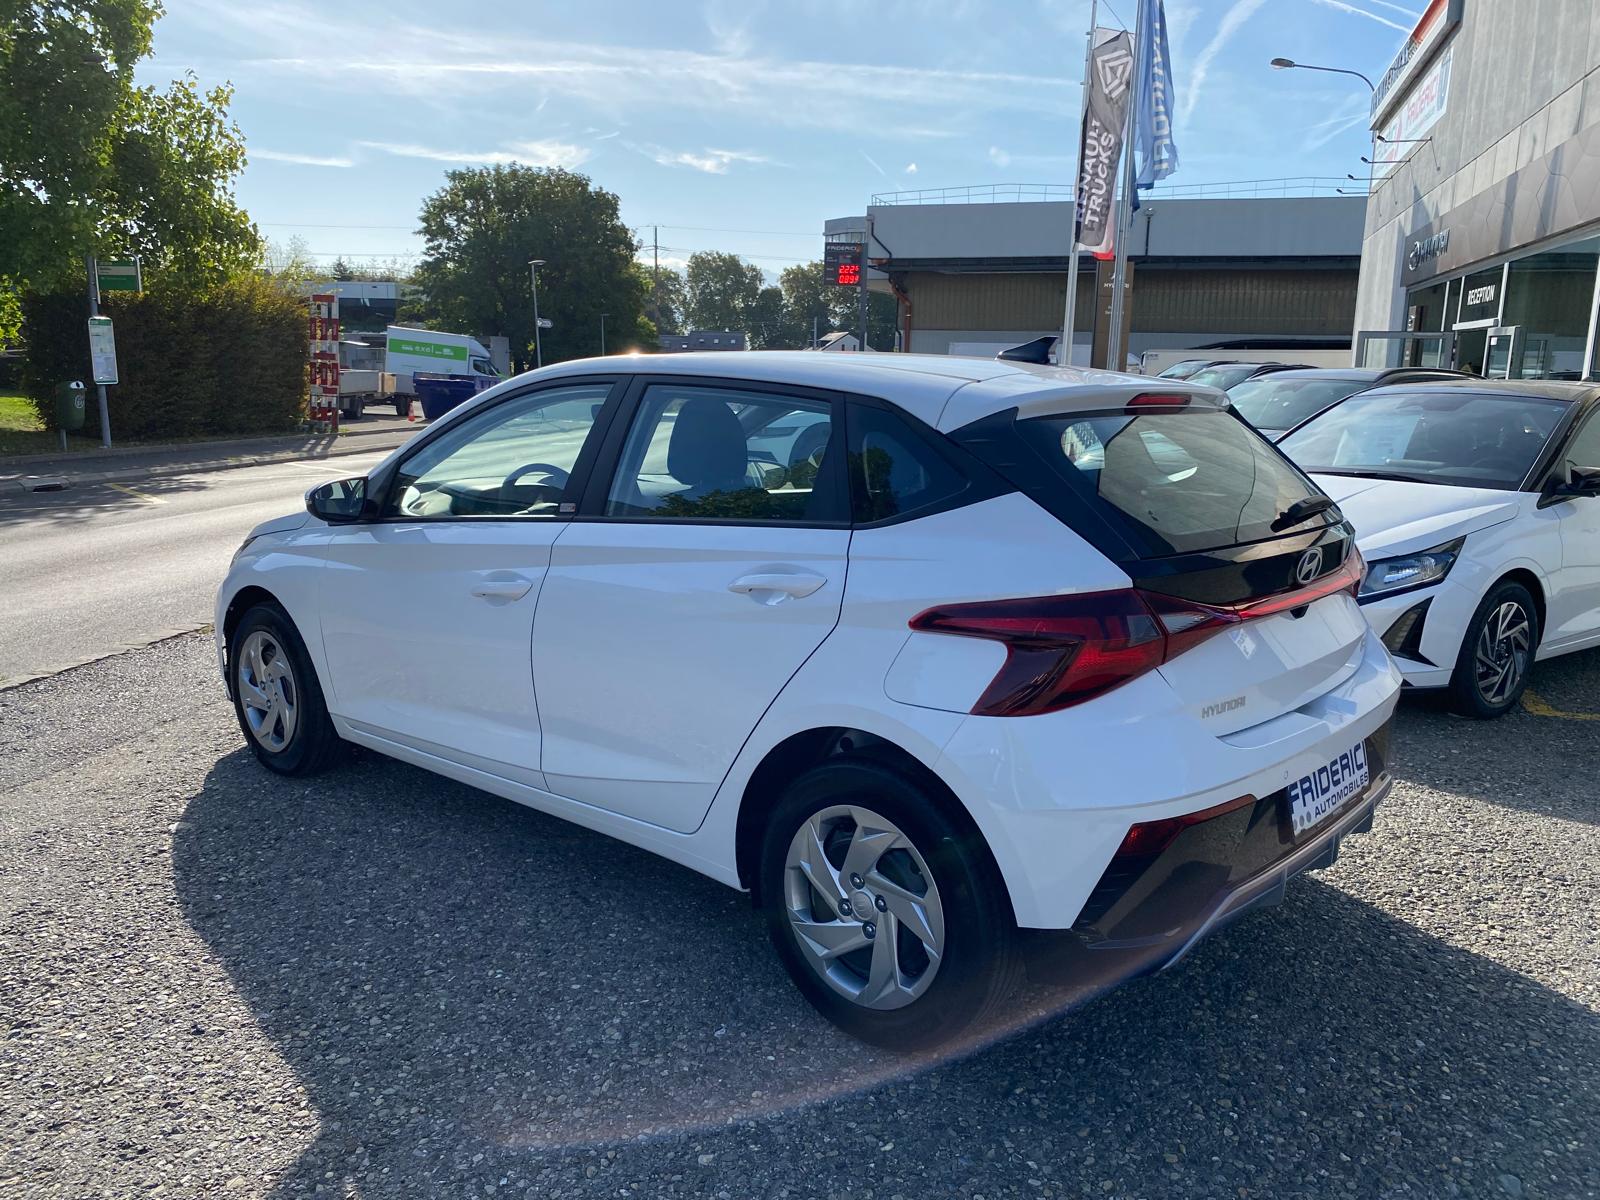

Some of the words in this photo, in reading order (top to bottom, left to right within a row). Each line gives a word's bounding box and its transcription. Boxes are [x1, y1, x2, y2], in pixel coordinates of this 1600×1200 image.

[1085, 131, 1114, 225] TRUCKS
[1467, 285, 1495, 305] RECEPTION
[1201, 696, 1246, 719] HYUNDAI
[1288, 740, 1367, 814] FRIDERICI
[1314, 771, 1368, 818] AUTOMOBILES
